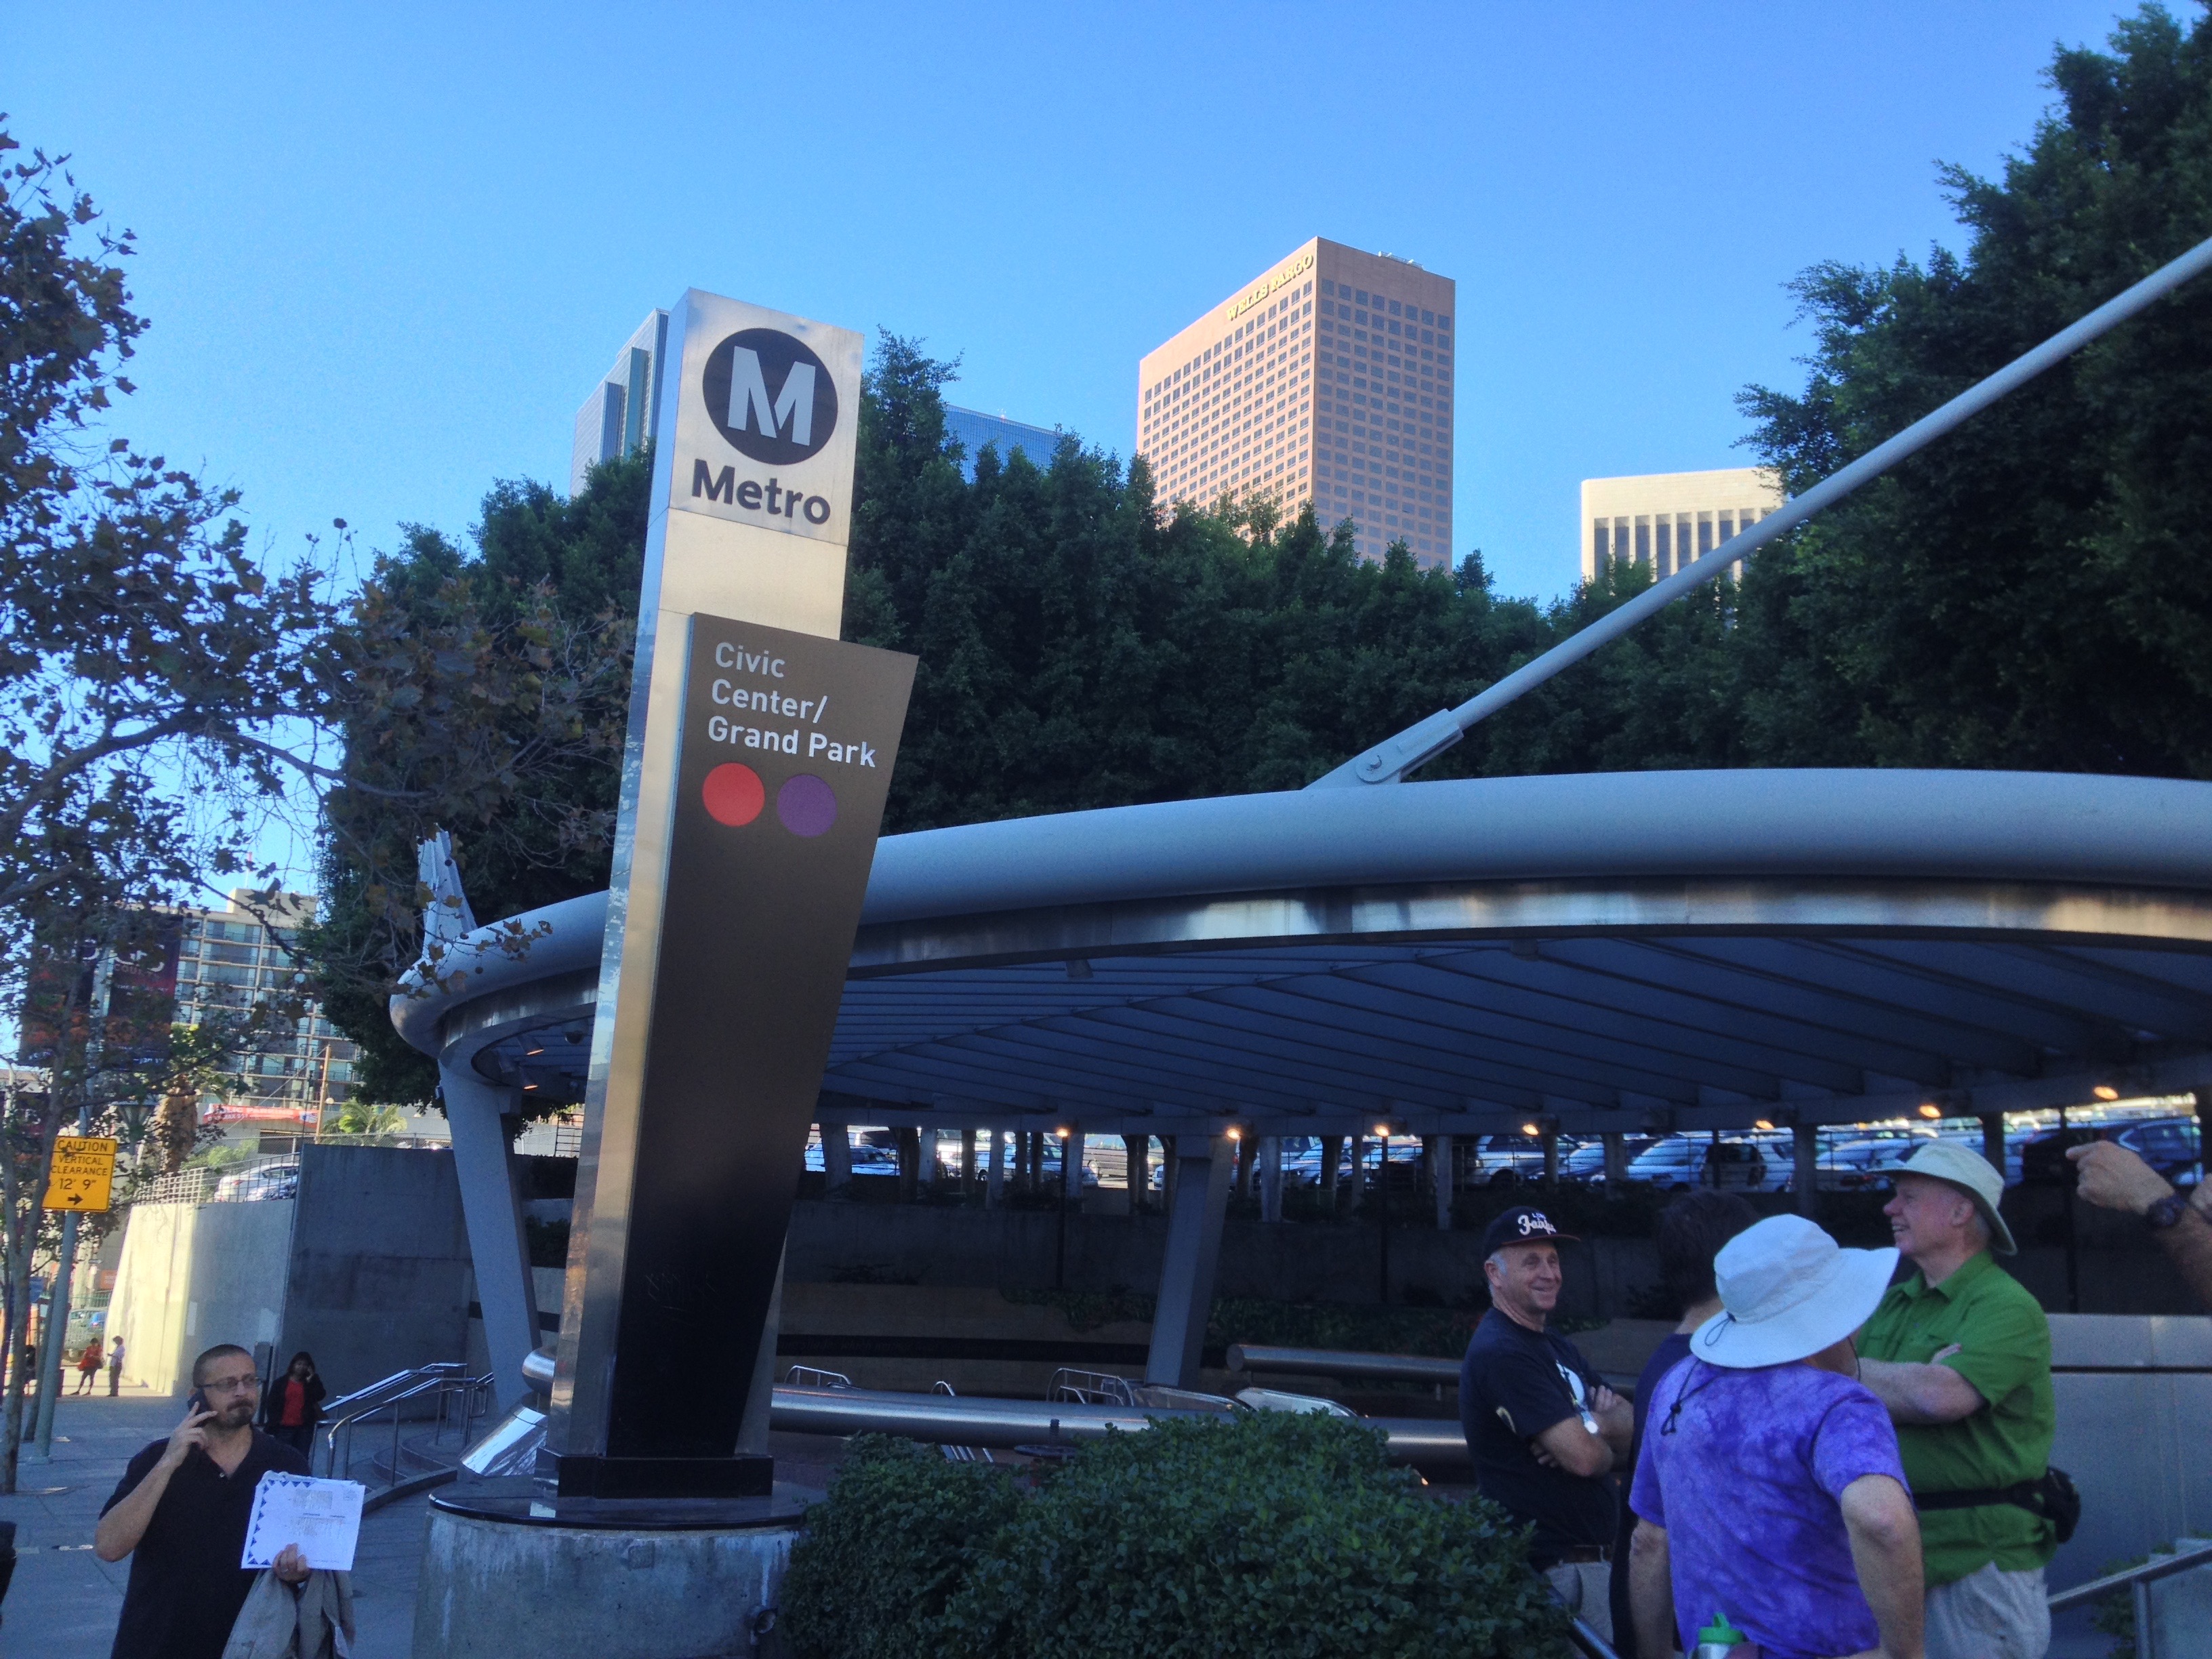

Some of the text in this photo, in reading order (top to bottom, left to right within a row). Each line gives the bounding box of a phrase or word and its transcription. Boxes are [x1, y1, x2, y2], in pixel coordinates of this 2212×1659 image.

[1227, 253, 1313, 321] WELLS FARGO
[728, 346, 816, 447] M
[691, 458, 832, 525] Metro
[715, 642, 785, 678] Civic
[712, 678, 828, 724] Center/
[708, 715, 876, 768] Grand Park
[57, 1140, 108, 1151] CAUTION
[59, 1155, 103, 1166] VERTICAL
[52, 1166, 108, 1176] CLEARANCE
